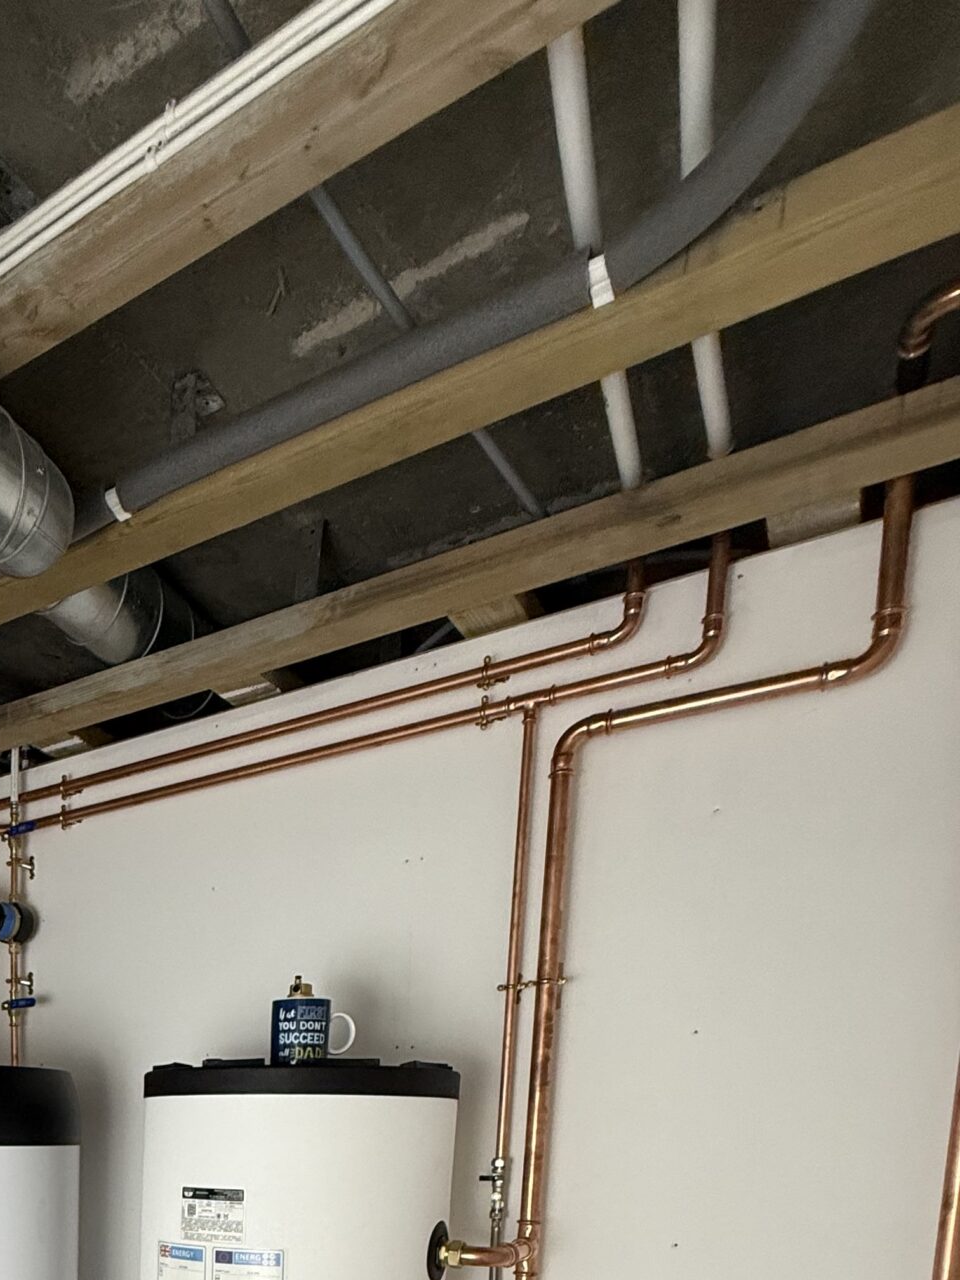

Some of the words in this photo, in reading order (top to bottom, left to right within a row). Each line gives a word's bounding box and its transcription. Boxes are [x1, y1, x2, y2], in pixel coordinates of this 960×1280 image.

[279, 1021, 296, 1031] YOU
[279, 1032, 325, 1044] SUCCEED
[296, 1047, 322, 1059] DAD
[171, 1247, 195, 1258] ENERGY
[235, 1253, 261, 1261] ENERG
